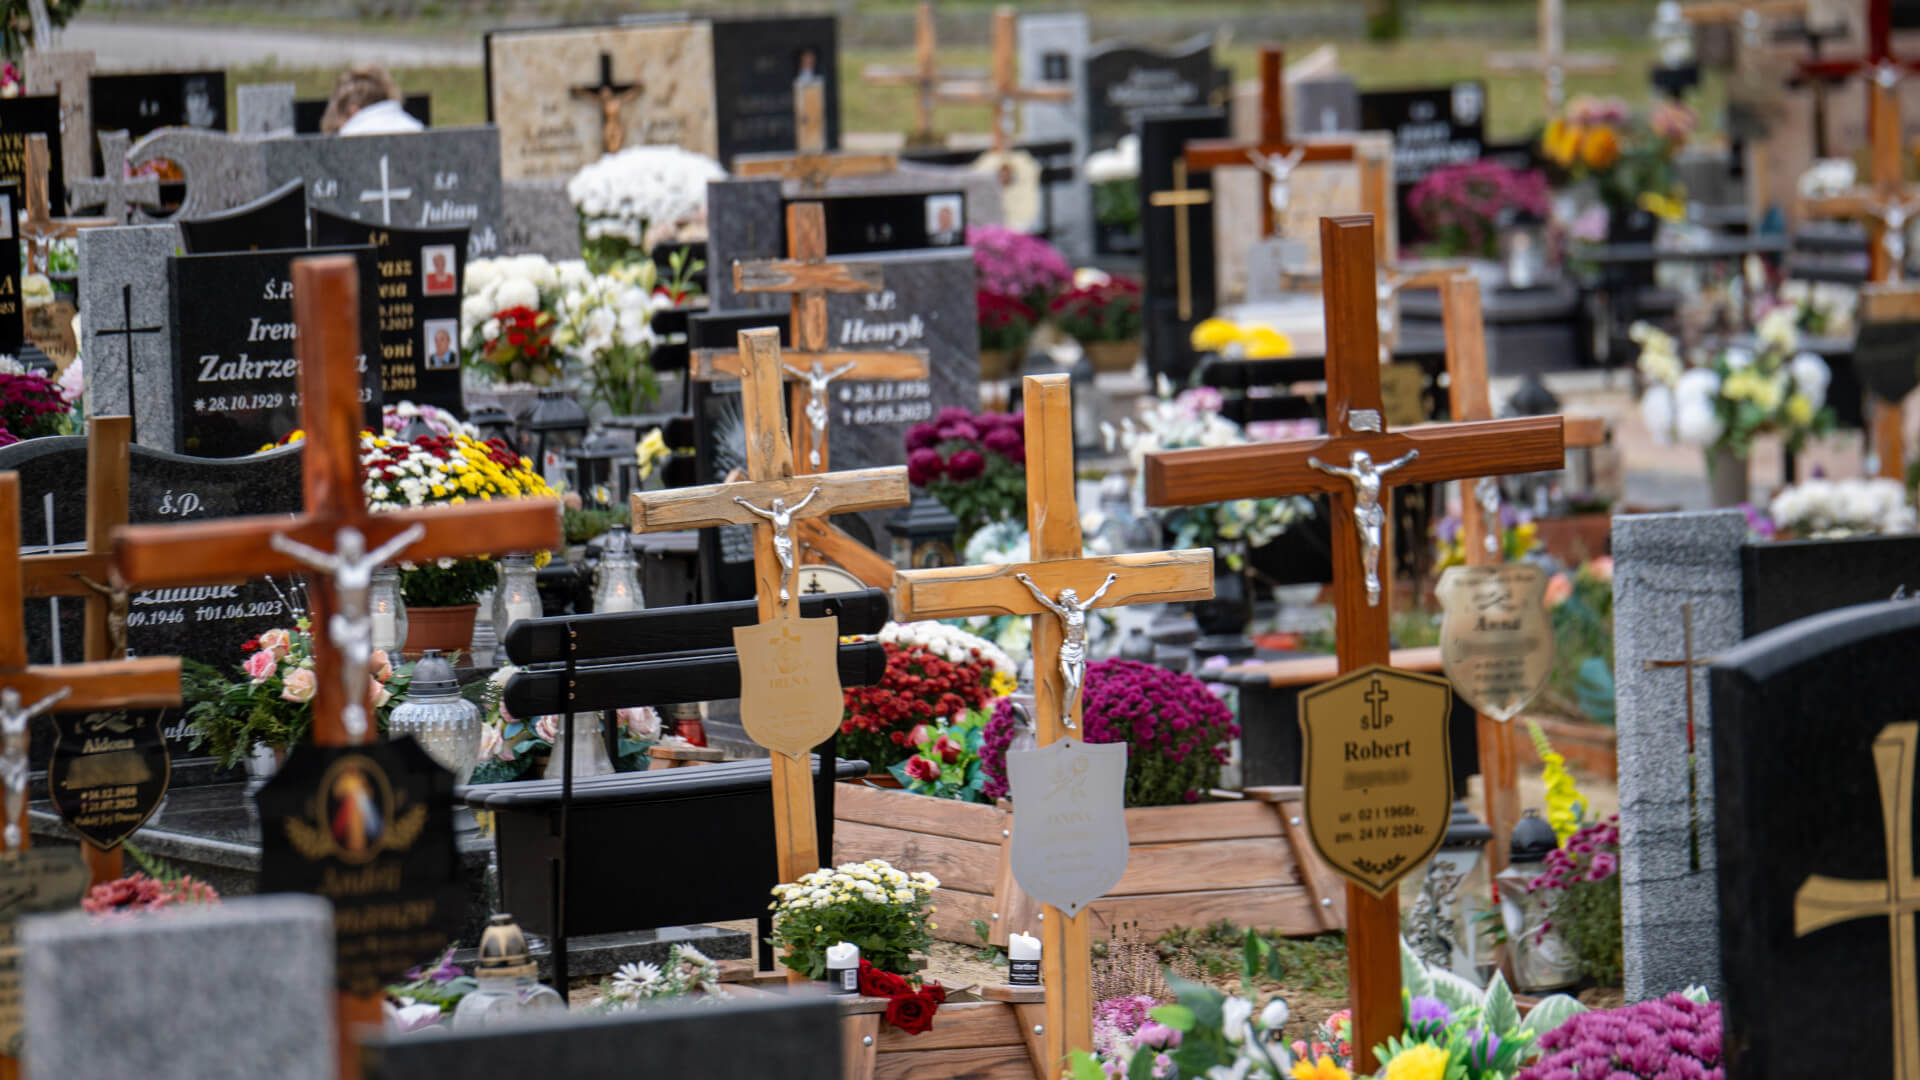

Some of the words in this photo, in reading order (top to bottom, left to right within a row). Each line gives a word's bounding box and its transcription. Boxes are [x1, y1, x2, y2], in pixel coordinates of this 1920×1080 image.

[415, 200, 478, 228] Julian
[247, 317, 301, 342] Iren
[841, 313, 924, 347] Henryk
[1473, 615, 1521, 632] Anna
[1344, 740, 1411, 762] Robert
